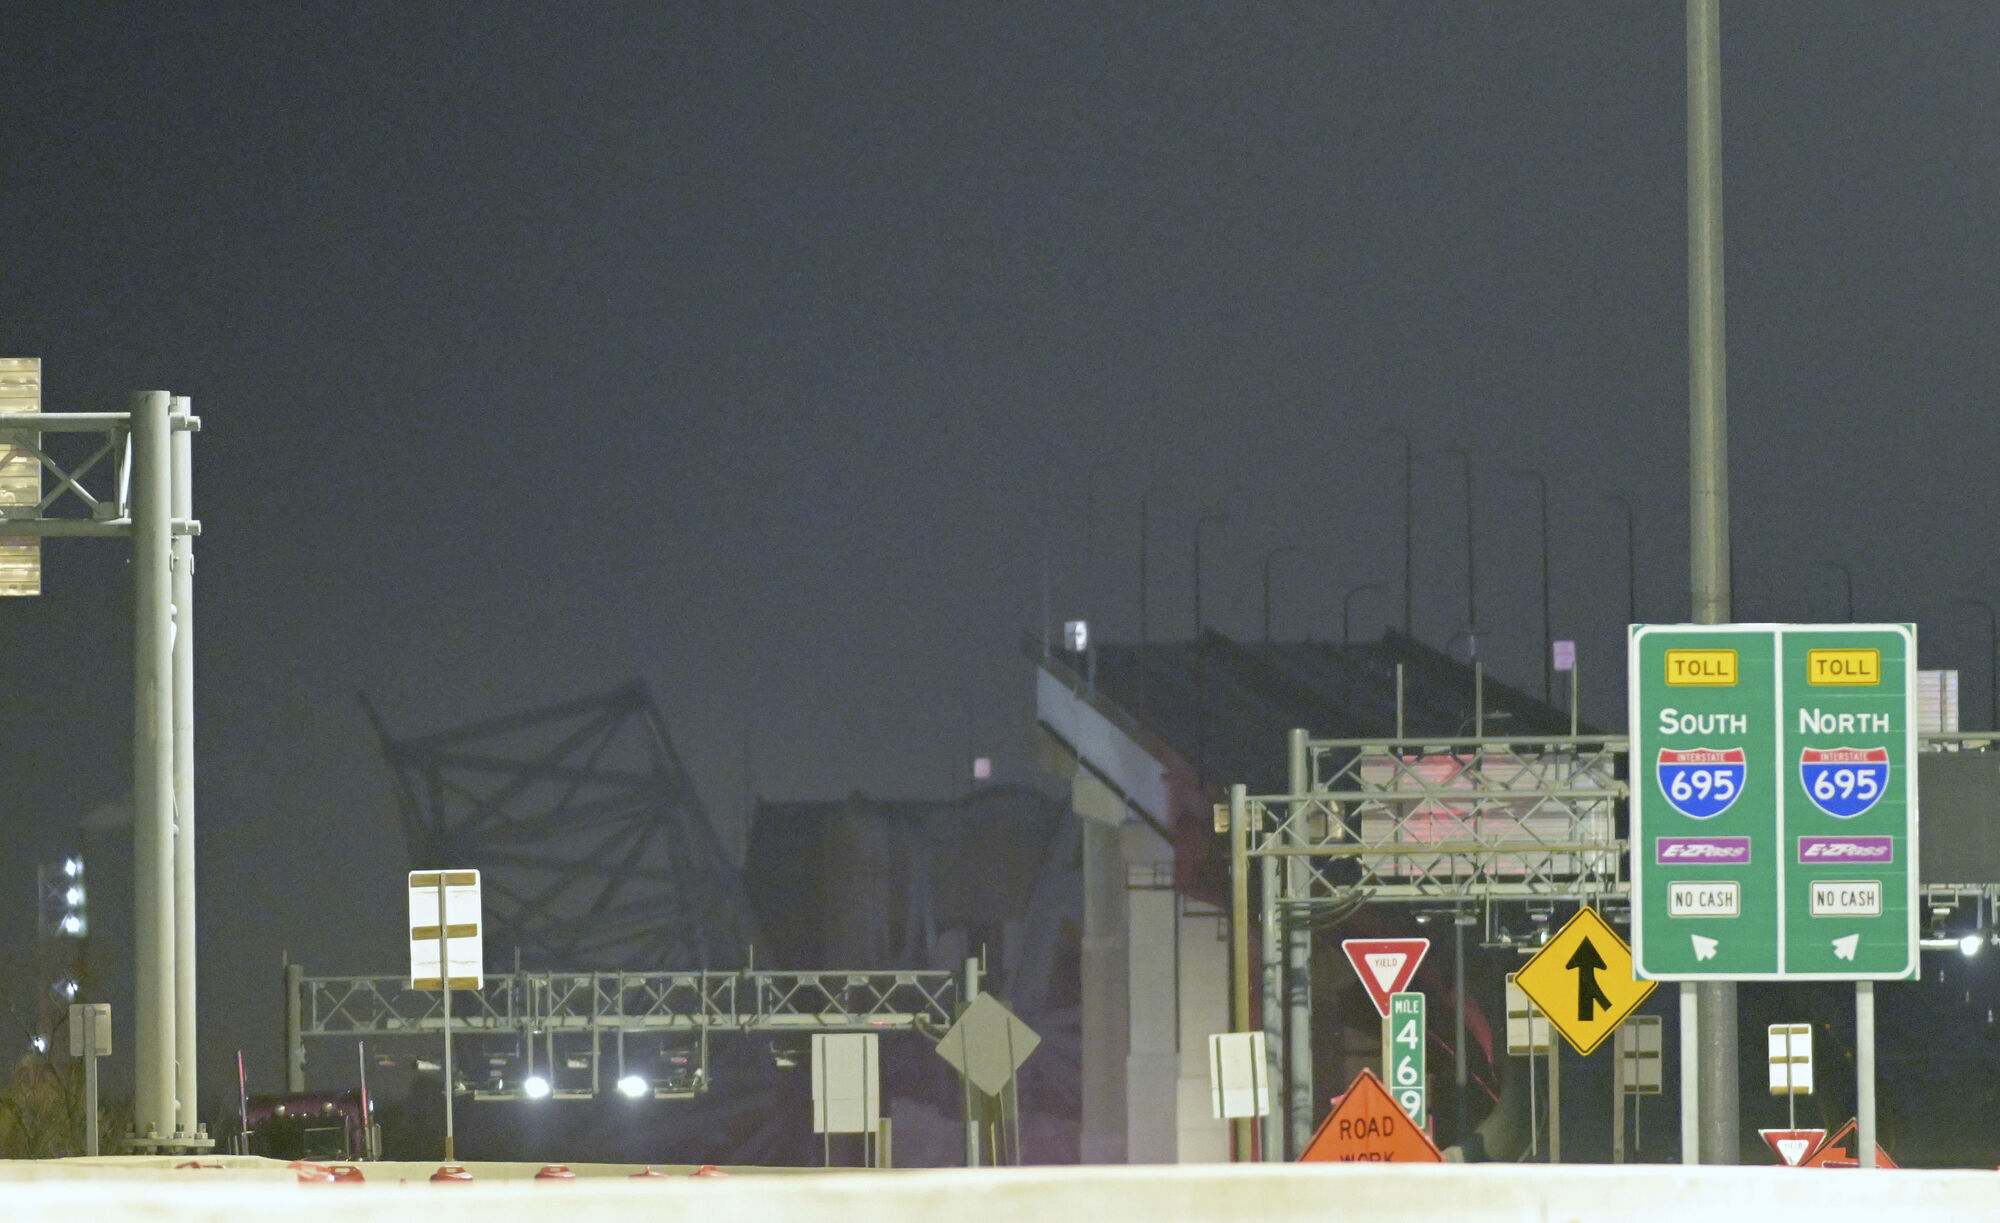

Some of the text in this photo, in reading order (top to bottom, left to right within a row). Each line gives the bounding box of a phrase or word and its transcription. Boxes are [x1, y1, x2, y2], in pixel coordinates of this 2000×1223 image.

[1674, 660, 1728, 676] TOLL
[1816, 659, 1871, 675] TOLL
[1659, 708, 1747, 734] SOUTH
[1799, 708, 1889, 734] NORTH
[1677, 752, 1725, 762] INTERSTATE
[1820, 751, 1868, 761] INTERSTATE
[1671, 770, 1735, 801] 695
[1814, 769, 1878, 800] 695
[1675, 891, 1733, 907] NO CASH
[1817, 891, 1875, 907] NO CASH
[1375, 958, 1398, 967] YIELD
[1395, 1000, 1419, 1014] MILE
[1340, 1116, 1394, 1140] ROAD
